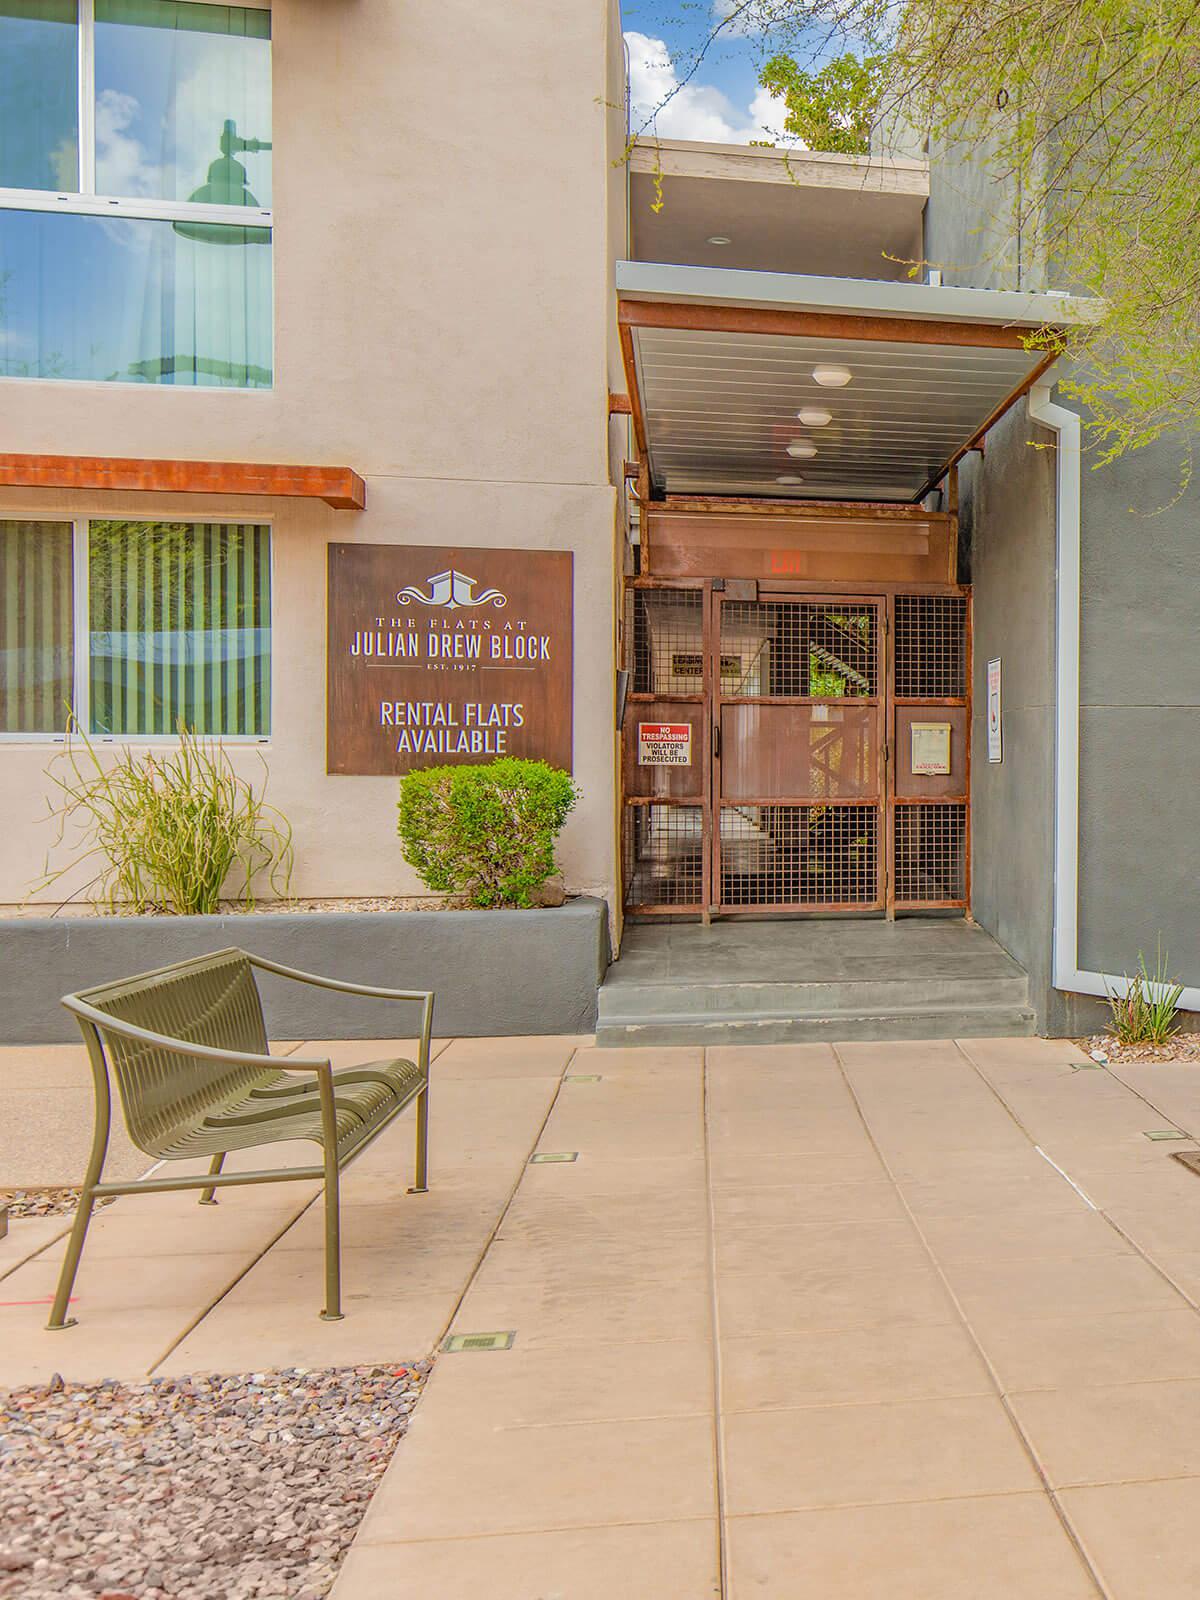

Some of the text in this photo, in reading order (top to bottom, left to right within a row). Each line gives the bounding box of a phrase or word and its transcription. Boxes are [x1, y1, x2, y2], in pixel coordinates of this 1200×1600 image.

[375, 617, 528, 631] THE FLATS AT
[350, 631, 551, 660] JULIAN DREW BLOCK
[426, 663, 477, 672] EST. 1917
[380, 702, 524, 727] RENTAL FLATS
[396, 730, 507, 753] AVAILABLE
